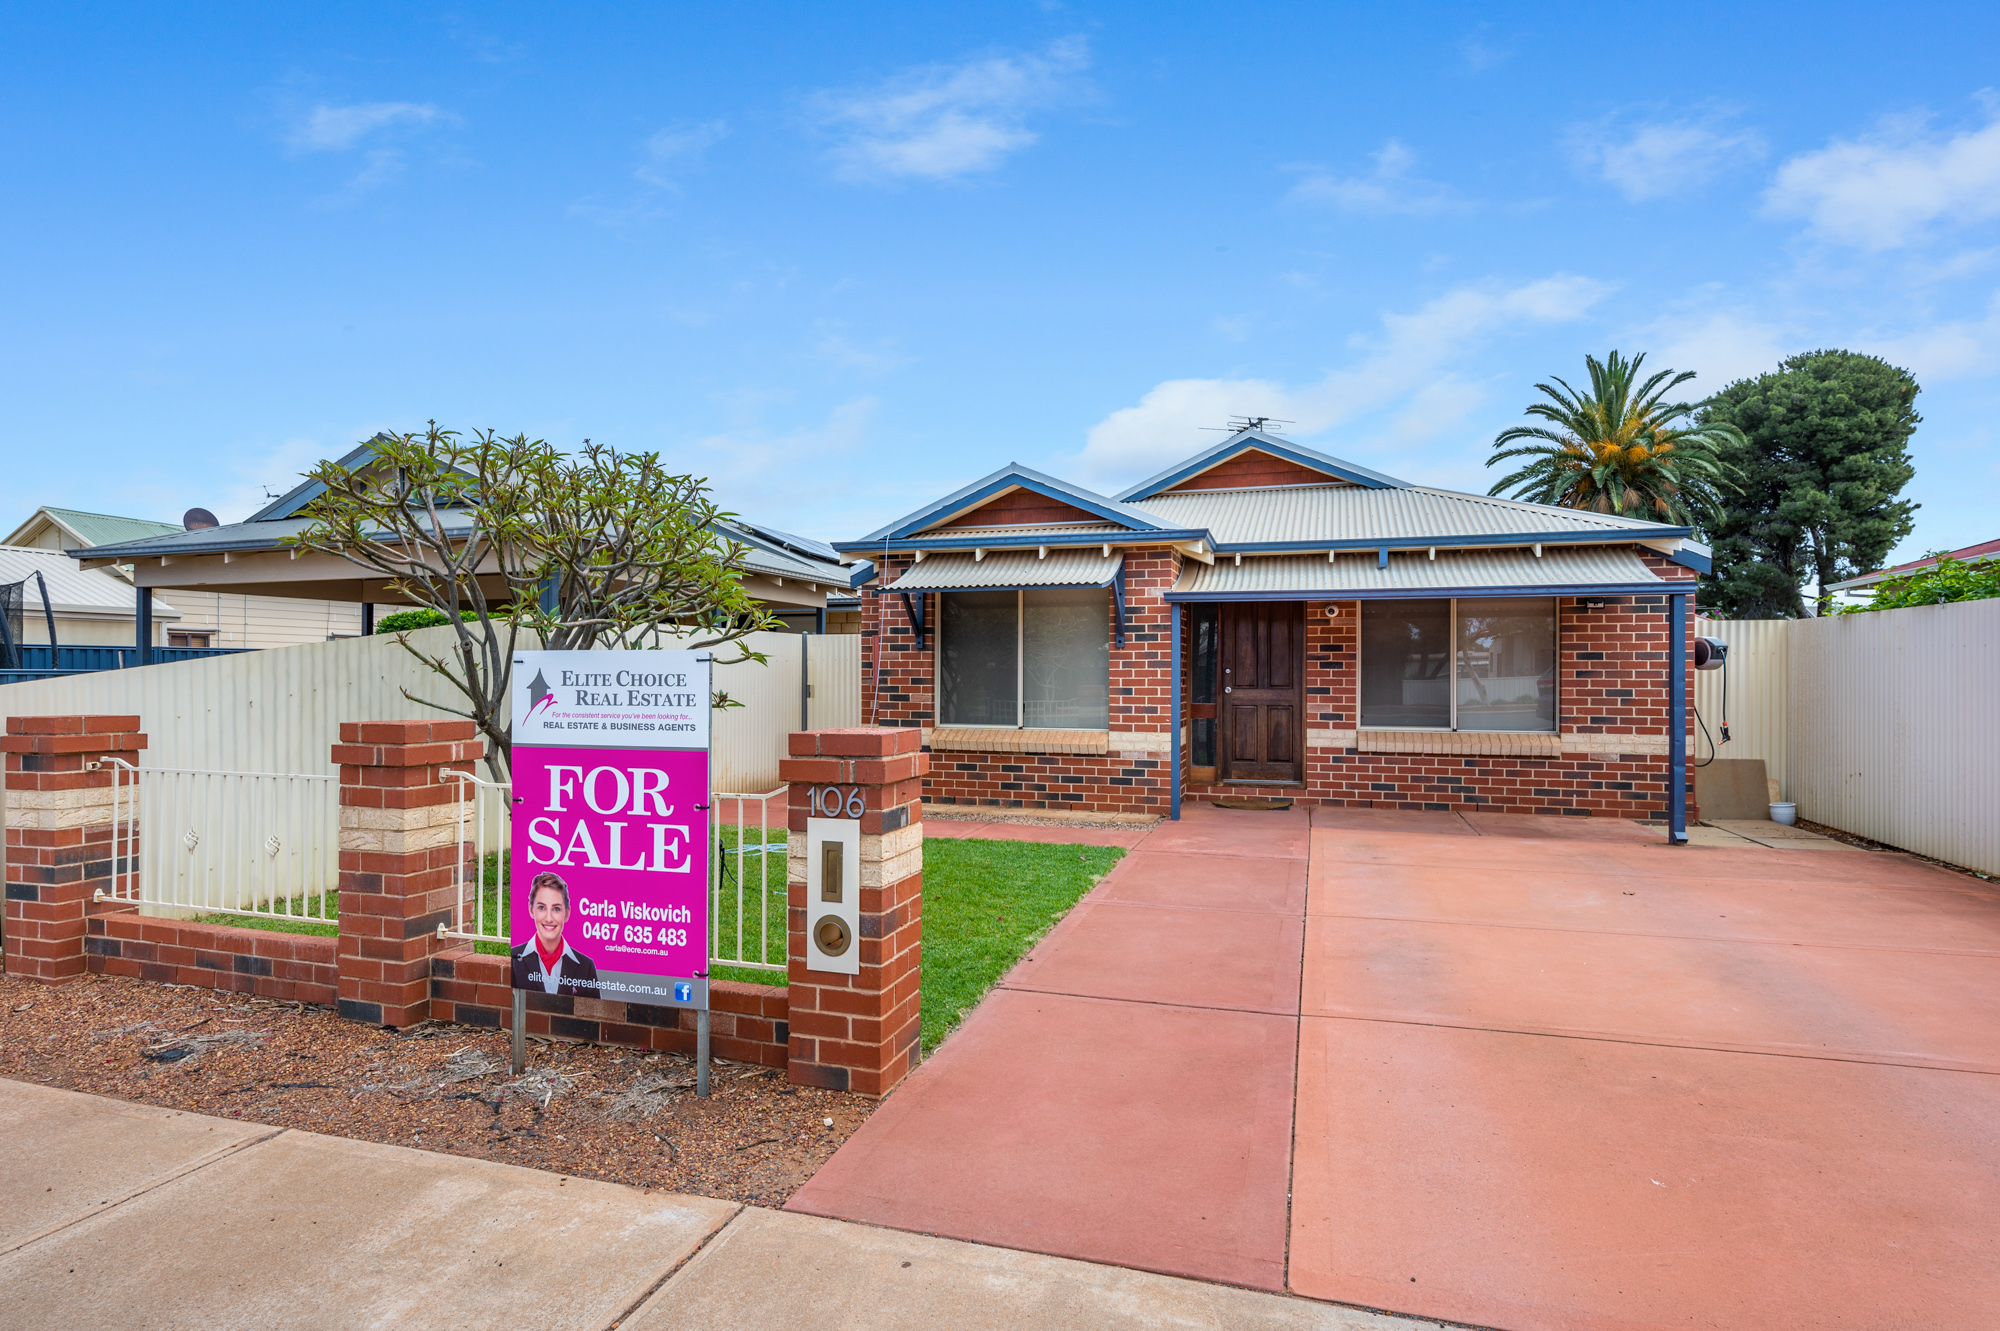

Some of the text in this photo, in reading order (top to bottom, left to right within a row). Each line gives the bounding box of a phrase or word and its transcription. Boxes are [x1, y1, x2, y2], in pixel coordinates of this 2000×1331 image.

[561, 669, 687, 687] ELITE CHOICE
[575, 689, 697, 707] REAL ESTATE
[567, 722, 599, 730] ESTATE
[601, 722, 608, 730] &
[610, 723, 655, 731] BUSINESS
[658, 723, 696, 732] AGENTS
[657, 713, 678, 721] looking
[543, 765, 674, 817] FOR
[806, 786, 865, 819] 106
[527, 817, 691, 874] SALE
[579, 897, 691, 923] Carla Viskovich
[582, 921, 687, 946] 0467 635 483
[605, 944, 669, 956] carla@ecre.com.au
